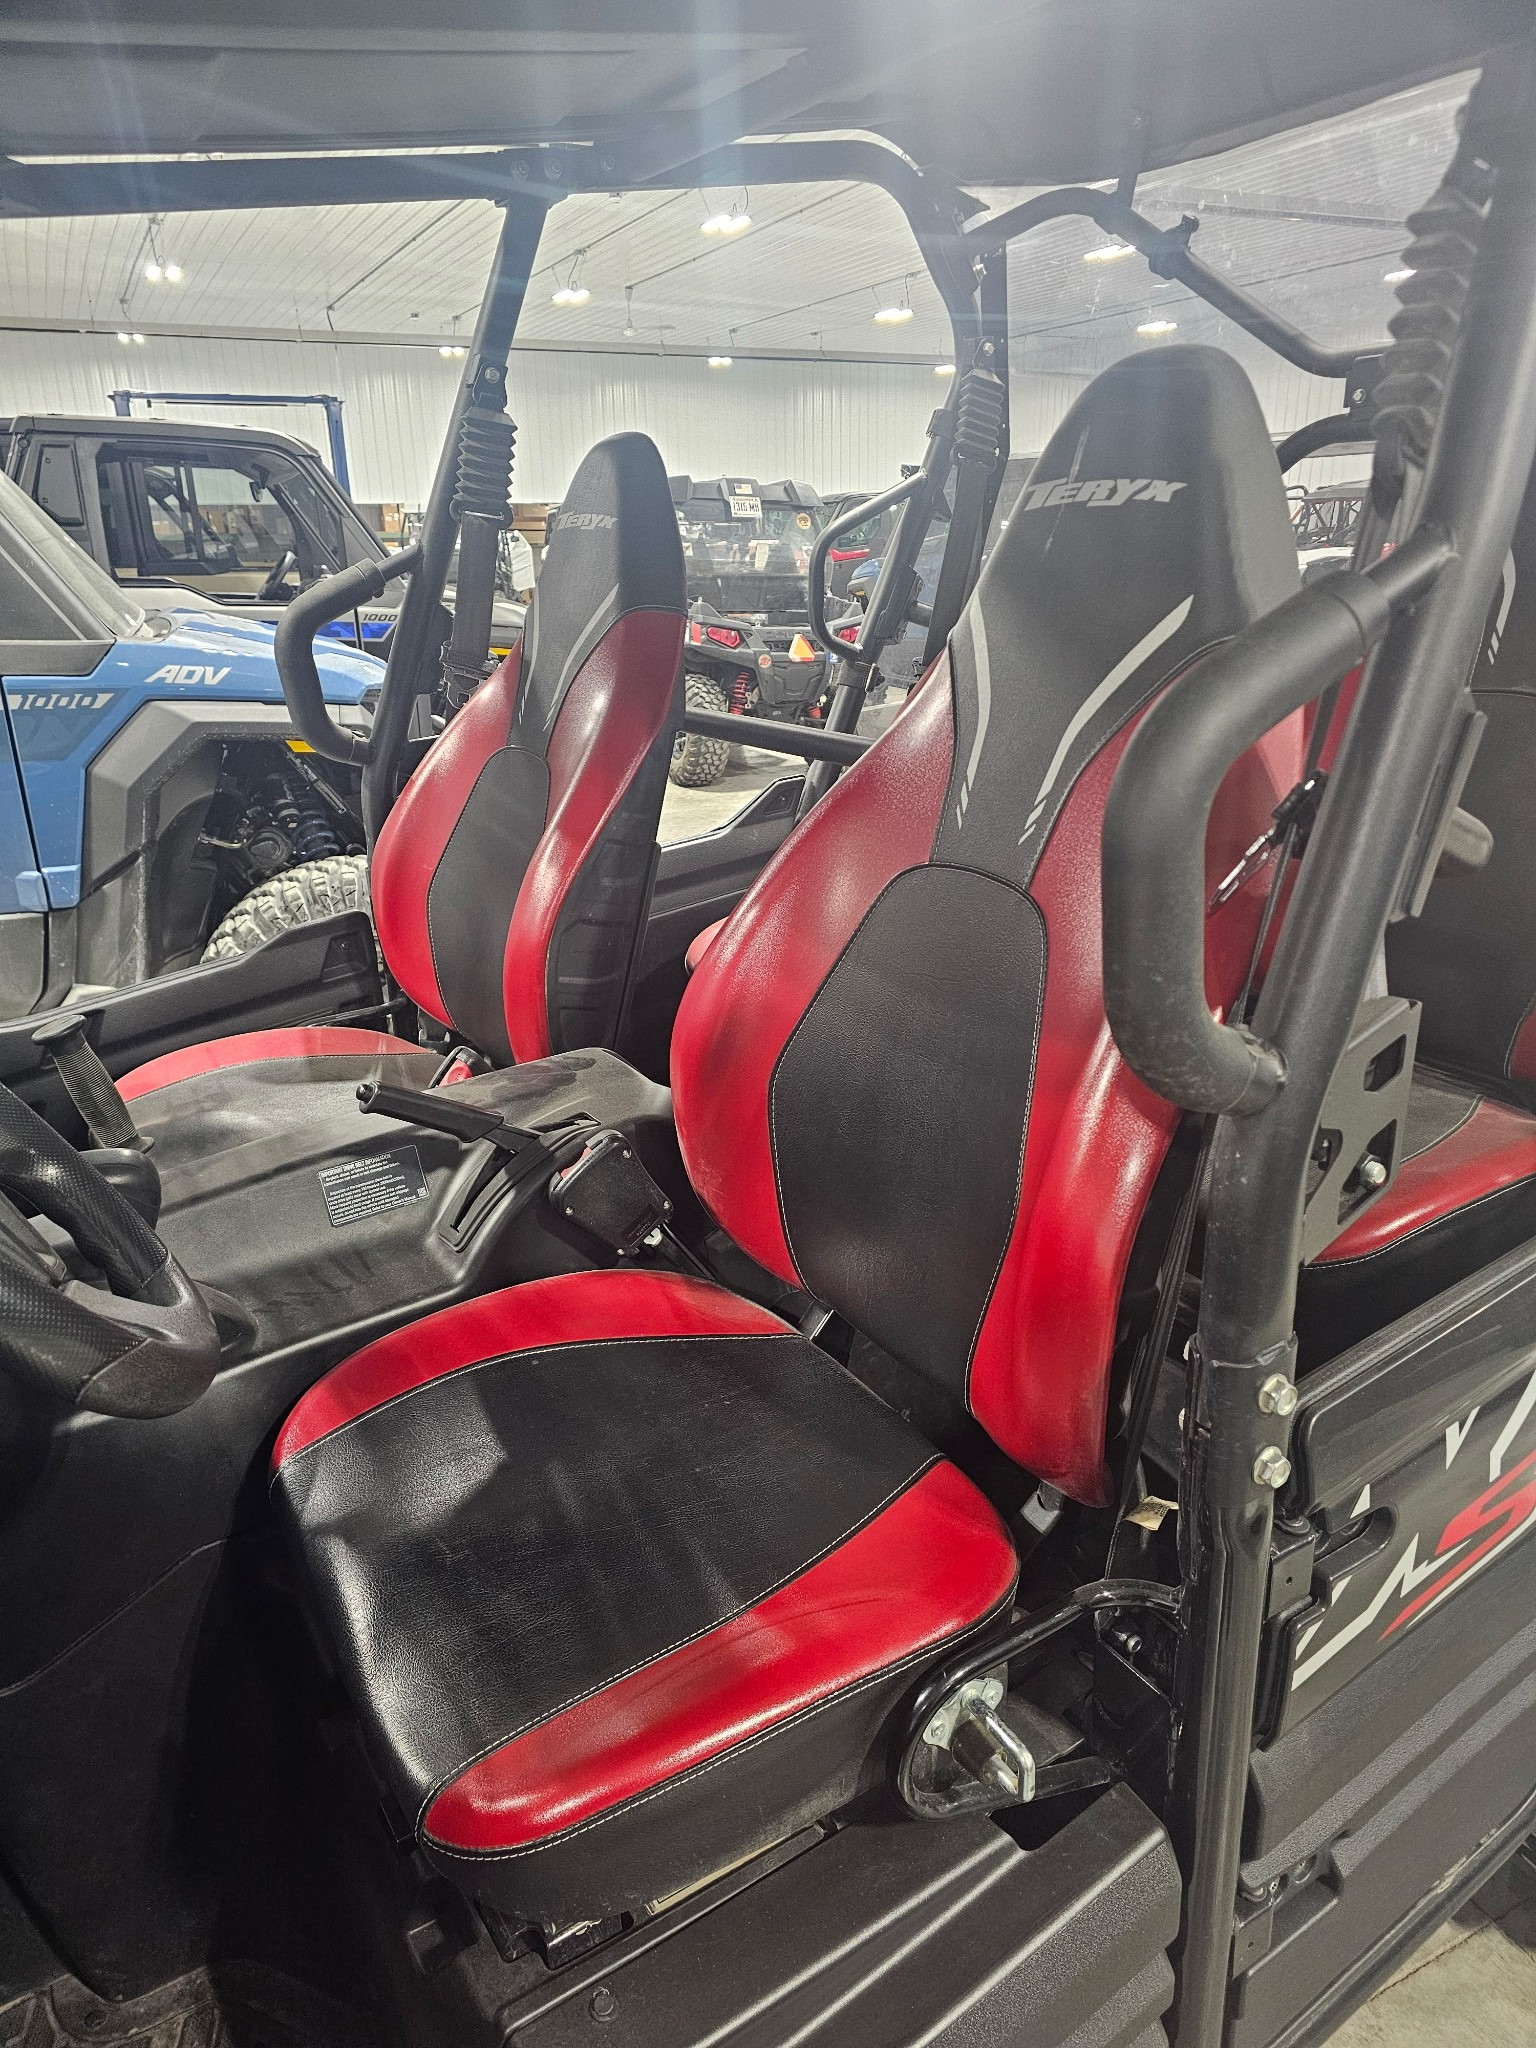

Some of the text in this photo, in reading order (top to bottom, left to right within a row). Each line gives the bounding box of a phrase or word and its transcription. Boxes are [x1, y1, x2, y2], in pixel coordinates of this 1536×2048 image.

[1024, 477, 1189, 512] TERYX
[556, 510, 619, 530] TERYX
[363, 613, 398, 622] 1000
[143, 664, 232, 685] ADV
